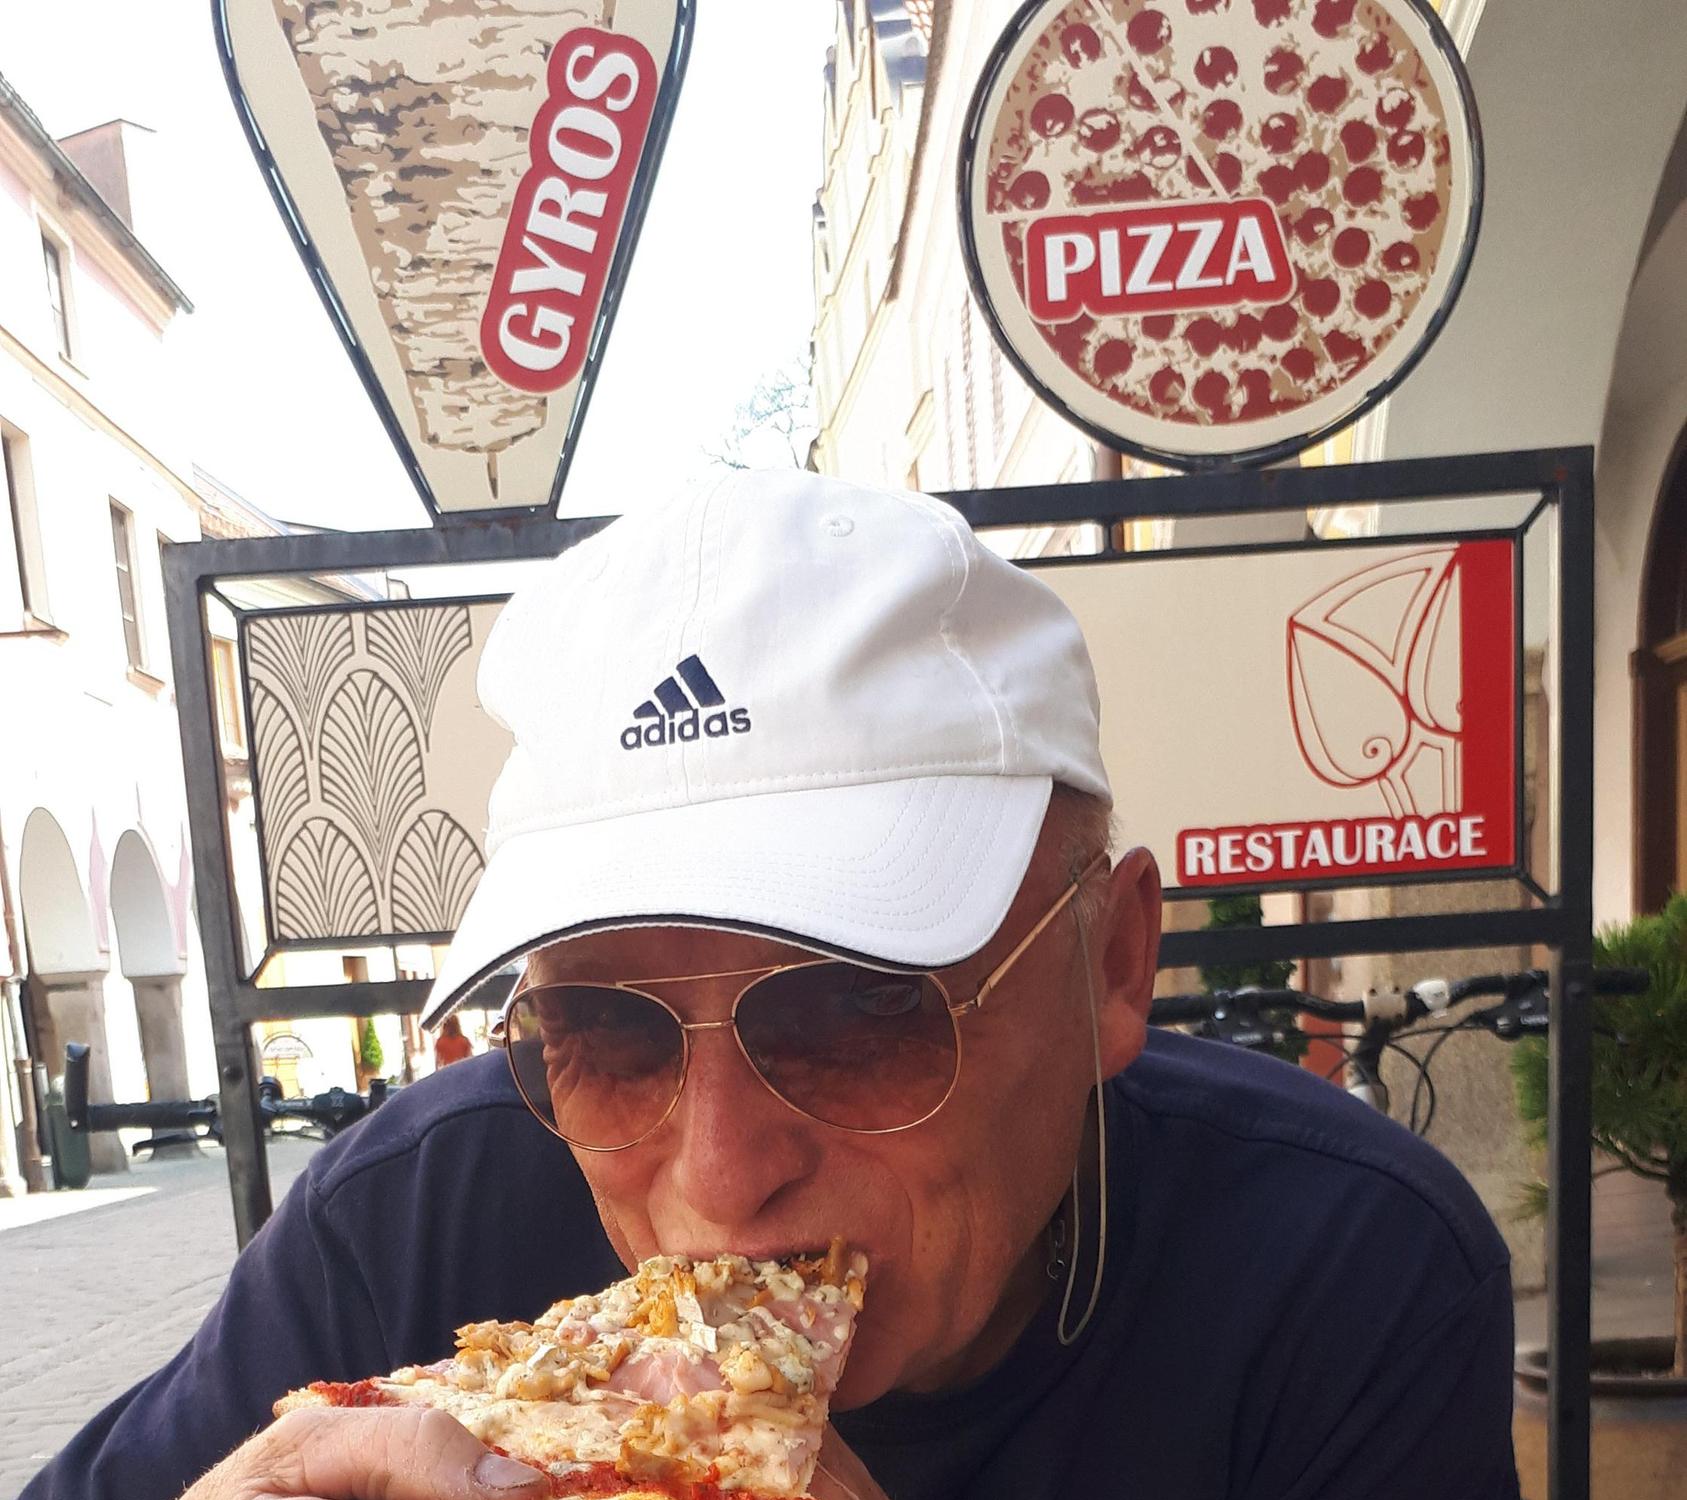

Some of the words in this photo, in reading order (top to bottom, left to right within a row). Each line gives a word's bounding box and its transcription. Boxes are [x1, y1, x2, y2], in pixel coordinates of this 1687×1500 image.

[498, 45, 640, 372] GYROS
[1044, 217, 1276, 302] PIZZA
[620, 708, 751, 750] adidas
[1184, 817, 1487, 876] RESTAURACE
